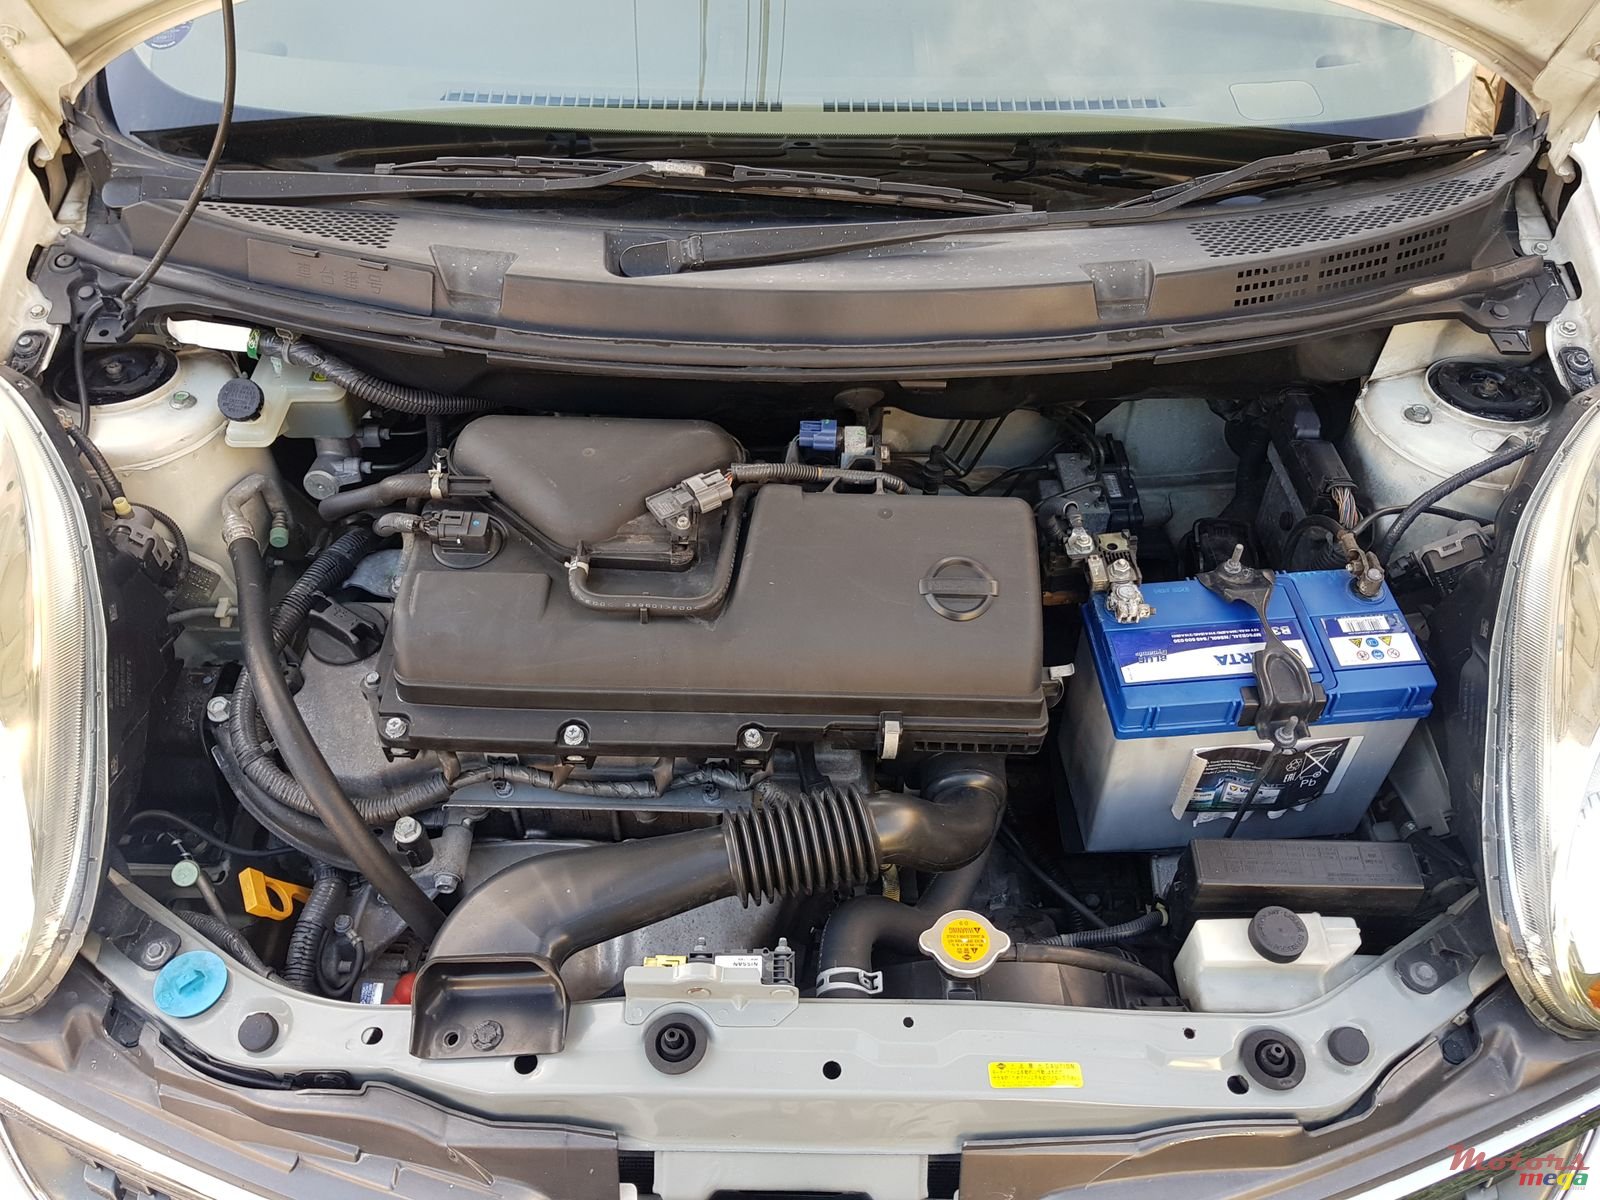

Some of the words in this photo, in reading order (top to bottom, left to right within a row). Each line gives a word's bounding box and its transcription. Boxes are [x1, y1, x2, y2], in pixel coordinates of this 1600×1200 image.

[1138, 654, 1168, 664] BLUE
[1300, 779, 1317, 788] Pb
[1045, 1062, 1076, 1070] CAUTION
